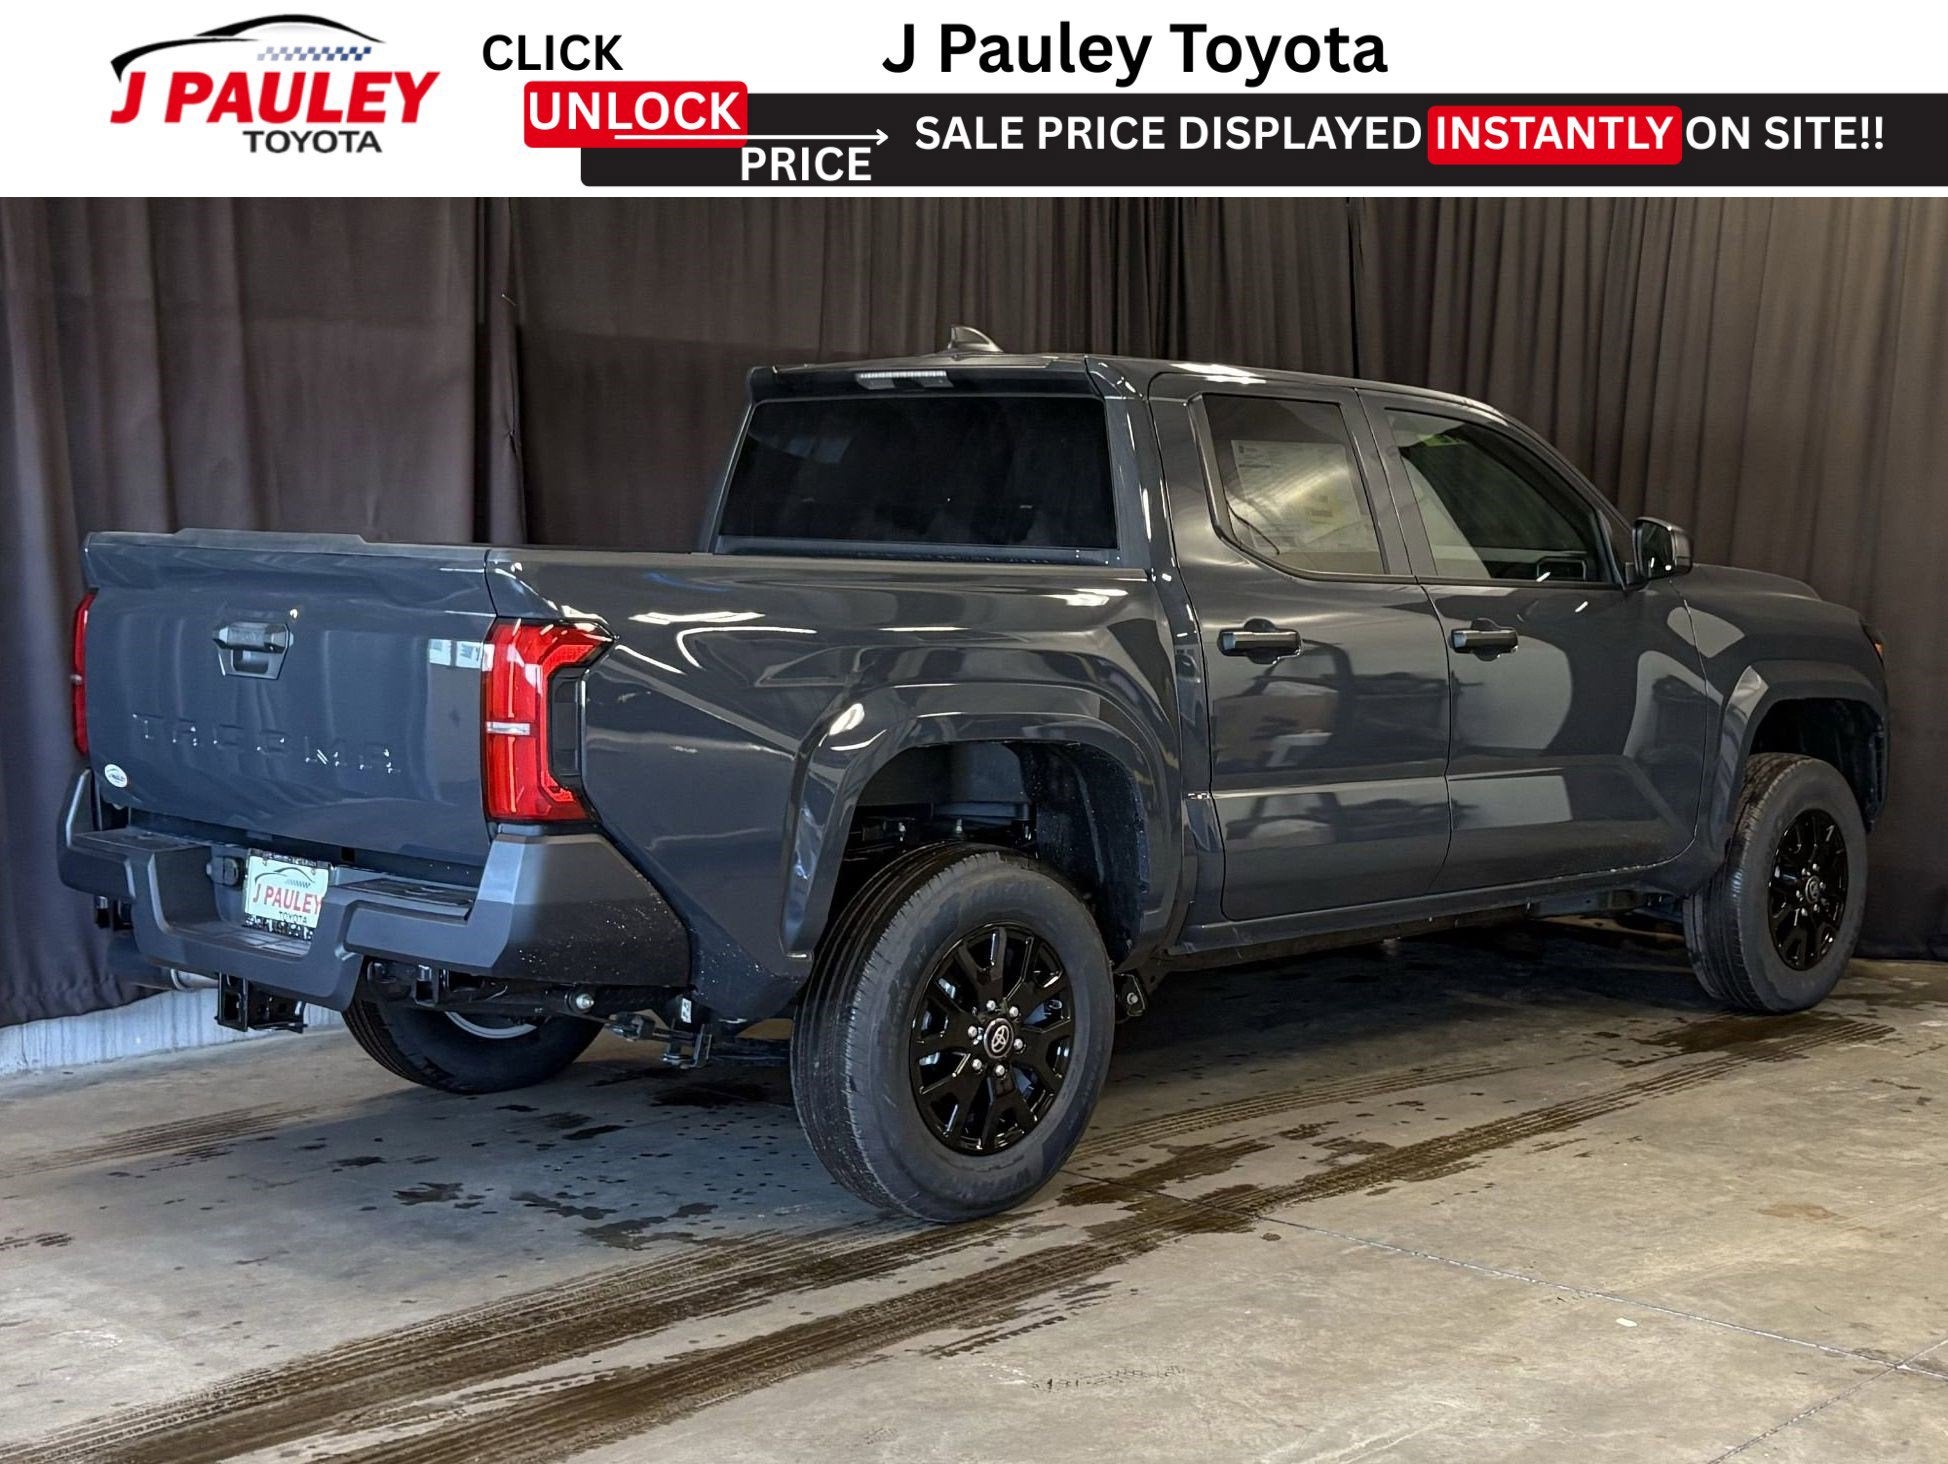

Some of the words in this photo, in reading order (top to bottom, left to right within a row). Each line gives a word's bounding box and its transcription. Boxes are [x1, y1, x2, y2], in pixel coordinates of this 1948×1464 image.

[252, 883, 262, 903] J
[264, 885, 322, 915] PAULEY
[278, 911, 308, 924] TOYOTA
